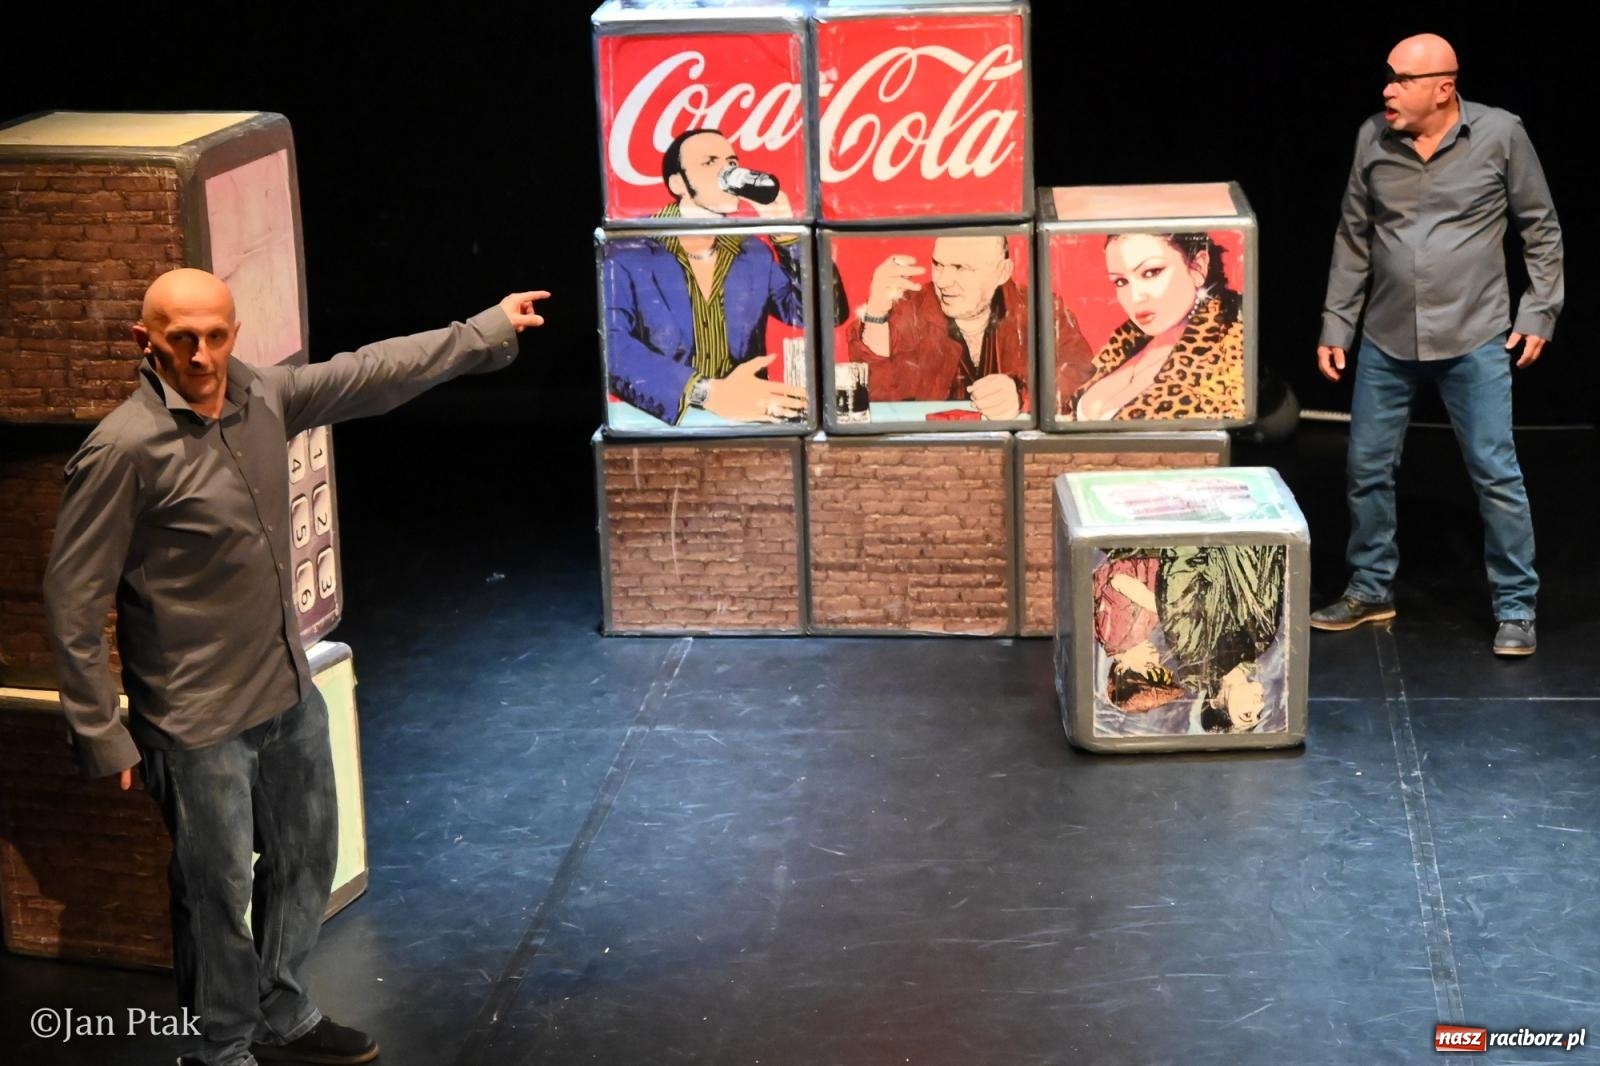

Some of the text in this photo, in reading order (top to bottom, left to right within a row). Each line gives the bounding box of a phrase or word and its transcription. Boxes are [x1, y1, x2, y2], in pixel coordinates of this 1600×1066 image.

[608, 44, 1023, 186] Coca Cola
[292, 458, 311, 606] 4 5 6
[317, 514, 327, 527] 2
[321, 576, 332, 593] 3
